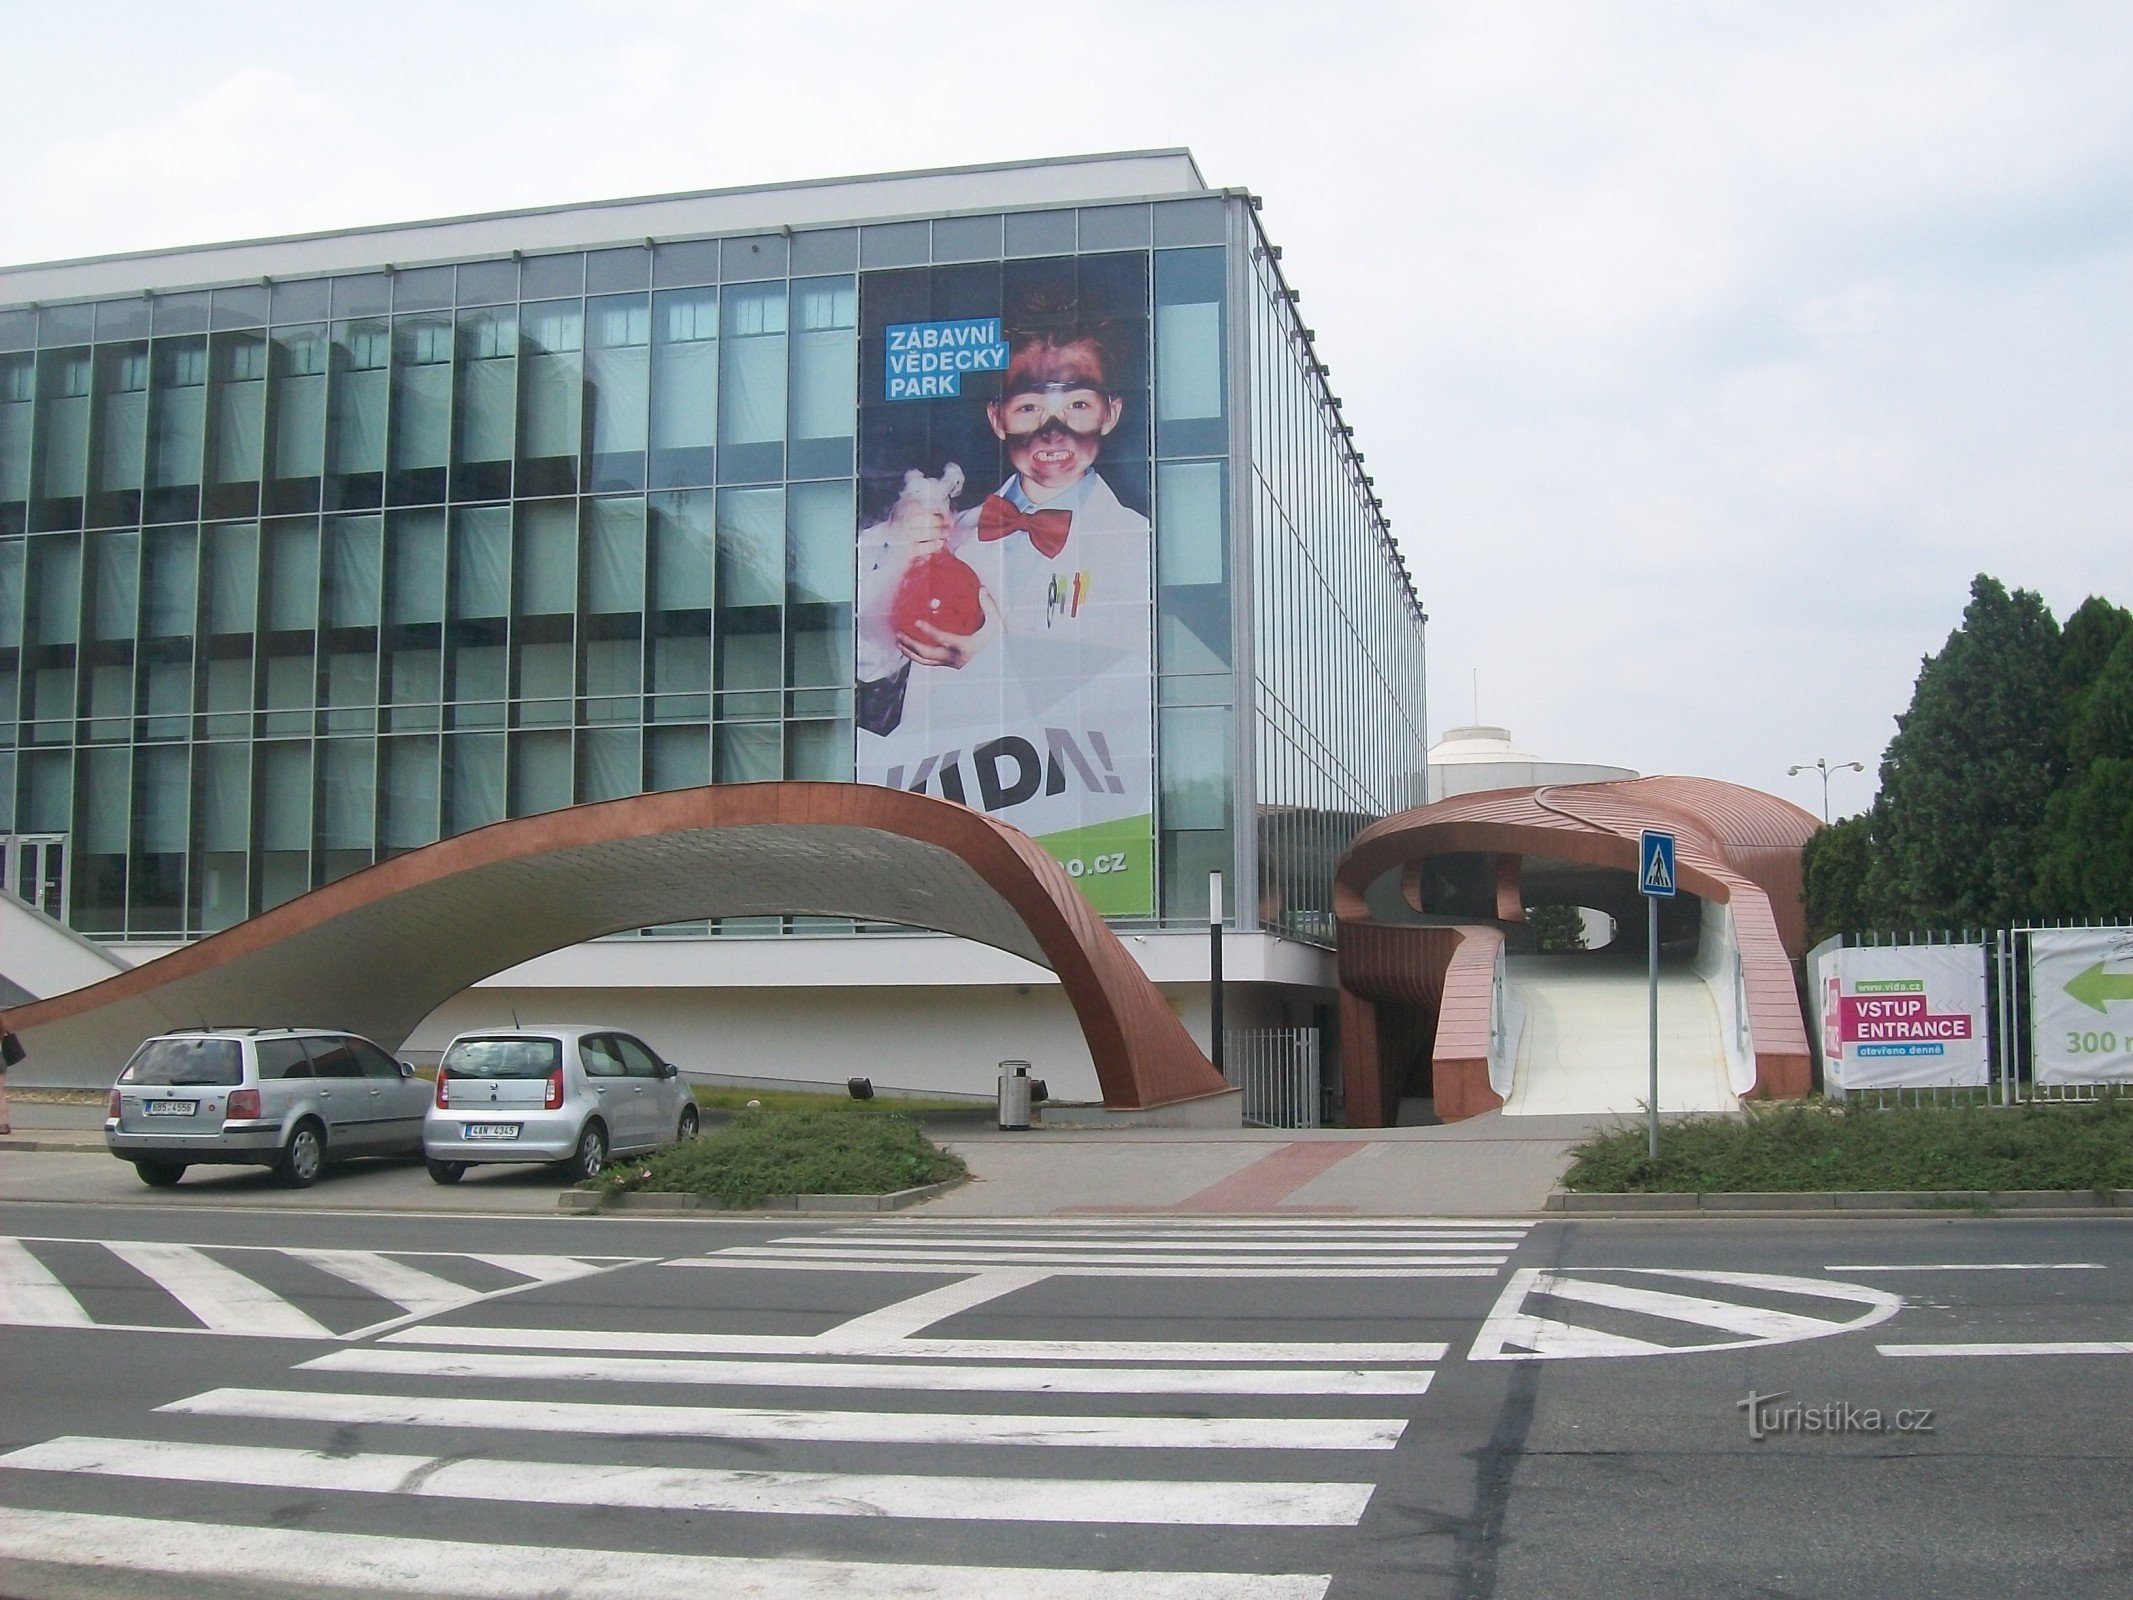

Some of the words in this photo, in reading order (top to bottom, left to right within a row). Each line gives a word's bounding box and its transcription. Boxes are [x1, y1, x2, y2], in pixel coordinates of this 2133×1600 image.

[890, 321, 995, 351] ZÁBAVNÍ
[890, 344, 1004, 374] VĚDECKÝ
[891, 375, 955, 398] PARK
[1058, 852, 1128, 878] o.cz
[1857, 982, 1922, 993] www.vida.cz
[1856, 1000, 1921, 1018] VSTUP
[1857, 1020, 1966, 1039] ENTRANCE
[1908, 1044, 1942, 1056] denně
[2066, 1031, 2117, 1054] 300
